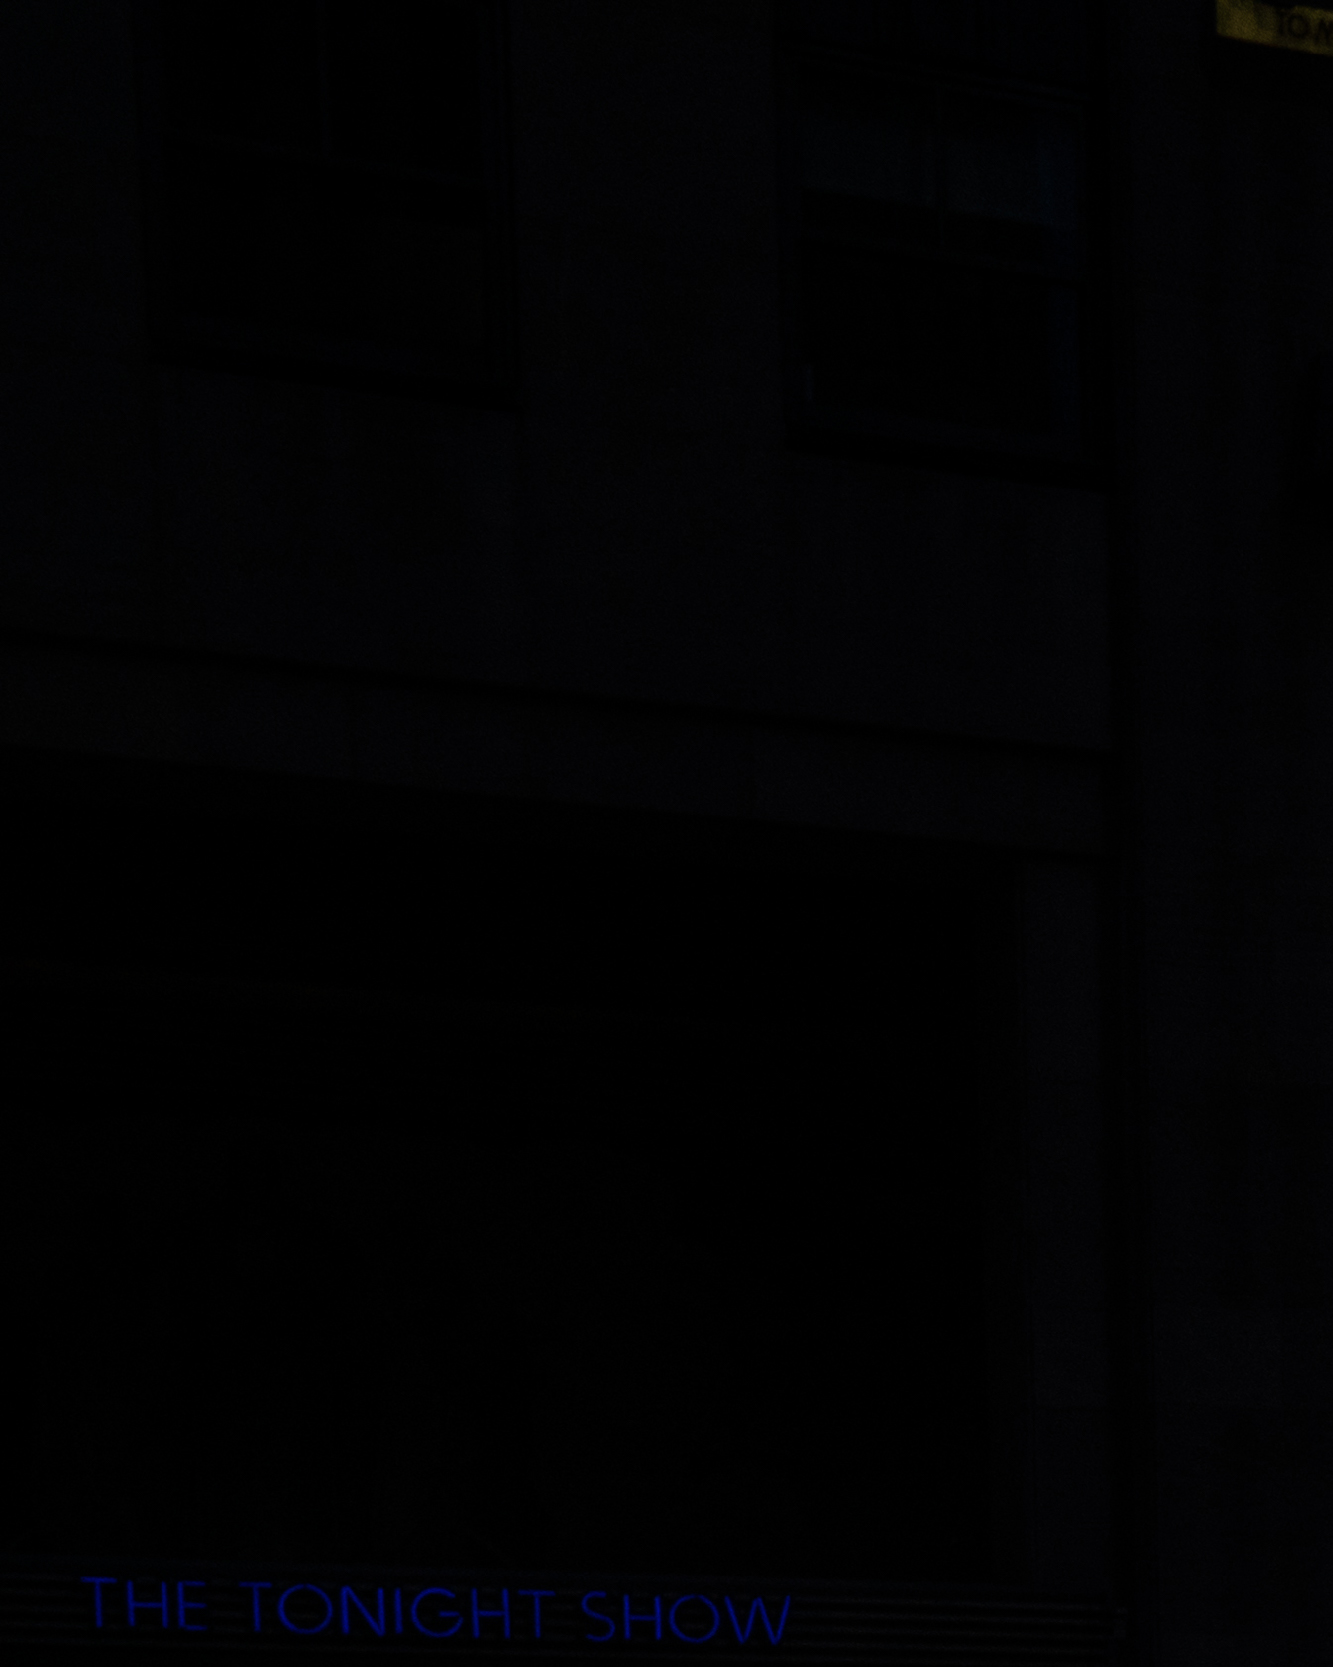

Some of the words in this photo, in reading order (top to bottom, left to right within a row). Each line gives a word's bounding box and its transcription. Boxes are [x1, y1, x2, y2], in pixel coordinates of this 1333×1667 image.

[1276, 6, 1311, 40] TO
[81, 1576, 206, 1629] THE
[240, 1581, 556, 1638] TONIGHT
[581, 1591, 790, 1645] SHOW
